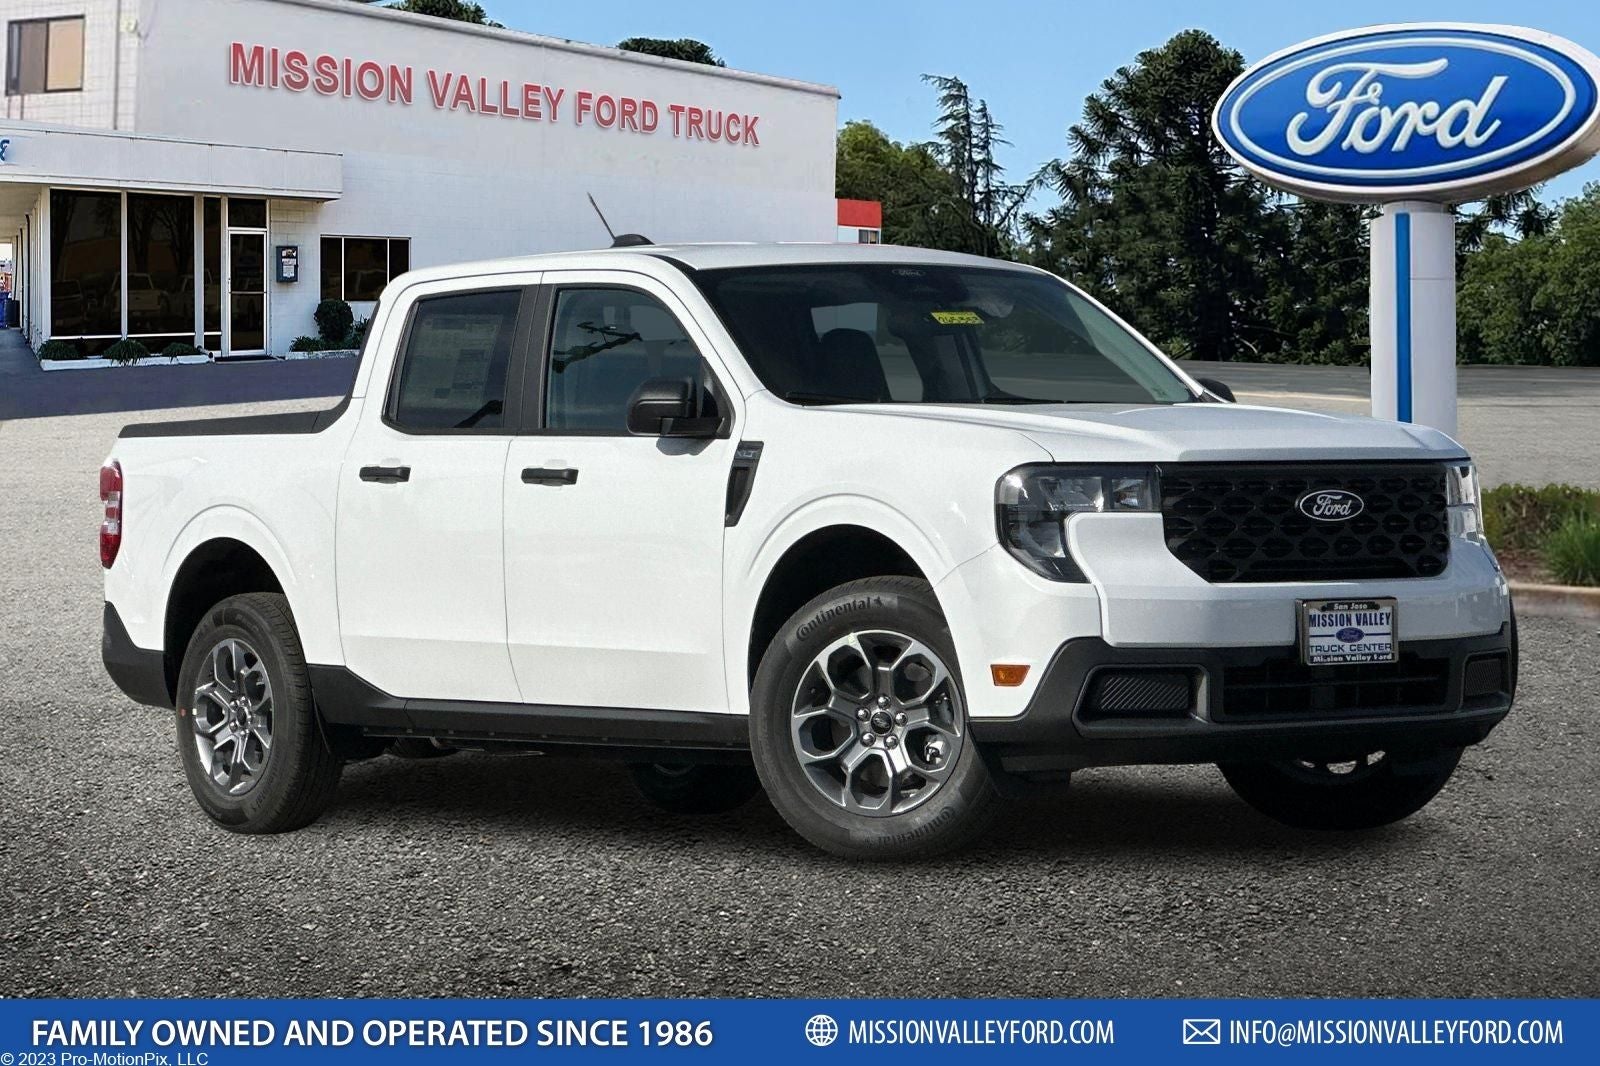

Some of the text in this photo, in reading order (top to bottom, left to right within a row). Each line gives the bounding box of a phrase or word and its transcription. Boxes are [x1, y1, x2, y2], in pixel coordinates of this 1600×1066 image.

[229, 41, 761, 146] MISSION VALLEY FORD TRUCK
[1286, 58, 1509, 156] Ford
[1312, 494, 1352, 516] Ford
[1333, 603, 1348, 611] San
[796, 595, 872, 642] Continental
[1308, 612, 1392, 628] MISSION VALLEY
[1309, 642, 1392, 653] TRUCK CENTER
[1345, 654, 1372, 663] Valley
